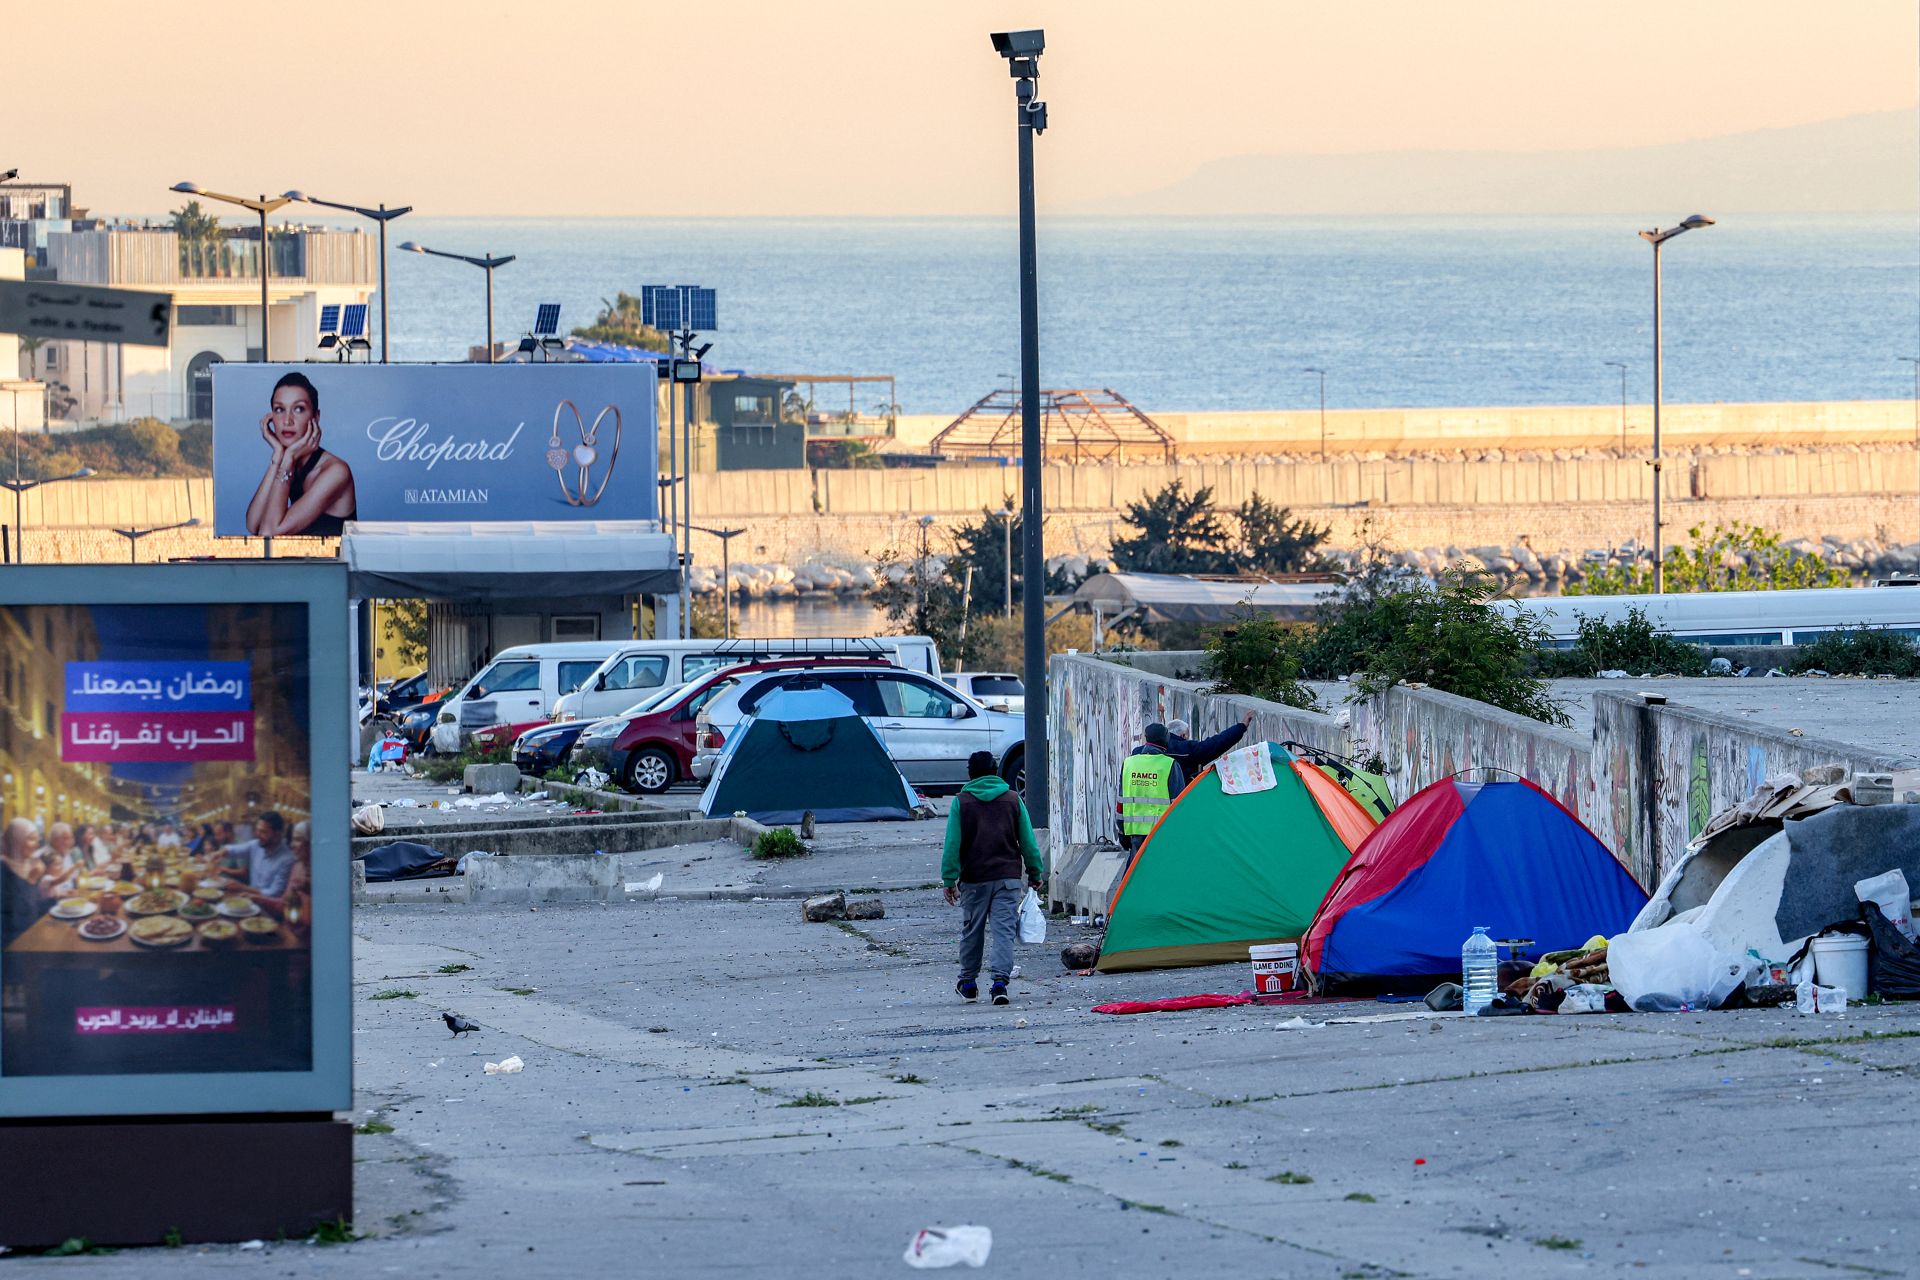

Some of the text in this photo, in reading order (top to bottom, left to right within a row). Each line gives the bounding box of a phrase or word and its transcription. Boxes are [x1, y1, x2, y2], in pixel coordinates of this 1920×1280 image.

[366, 416, 525, 471] Chopard
[167, 671, 243, 700] رمضان
[1131, 772, 1158, 780] RAMCO
